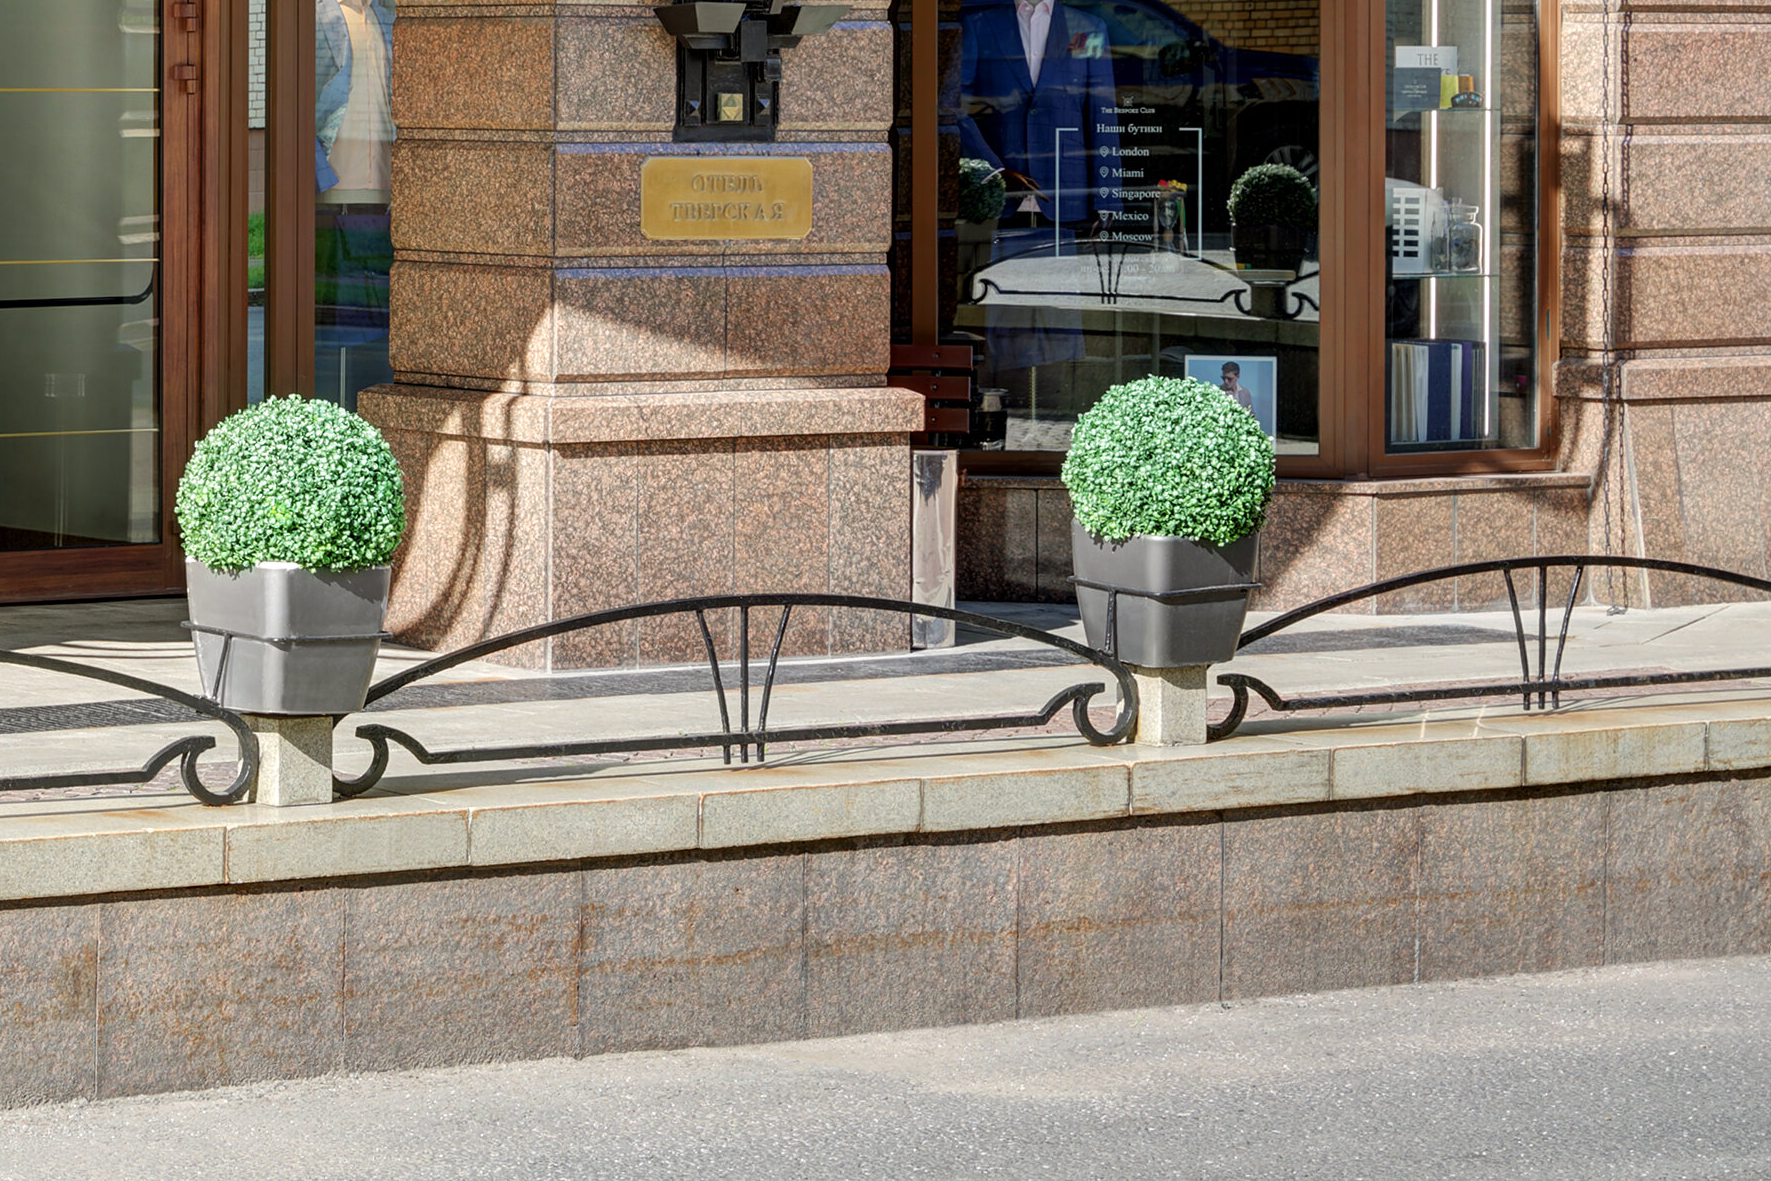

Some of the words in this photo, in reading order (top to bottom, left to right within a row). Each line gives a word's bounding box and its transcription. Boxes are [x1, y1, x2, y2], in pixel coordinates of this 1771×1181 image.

[1416, 53, 1439, 66] THE
[1096, 123, 1126, 133] Наши
[1127, 123, 1163, 135] бутики
[1112, 146, 1150, 157] London
[1112, 168, 1144, 178] Miami
[691, 173, 765, 194] ОТЕЛЬ
[1111, 188, 1161, 200] Singapore
[670, 200, 786, 222] ТВЕРСКАЯ
[1112, 210, 1149, 220] Mexico
[1112, 231, 1154, 241] Moscow
